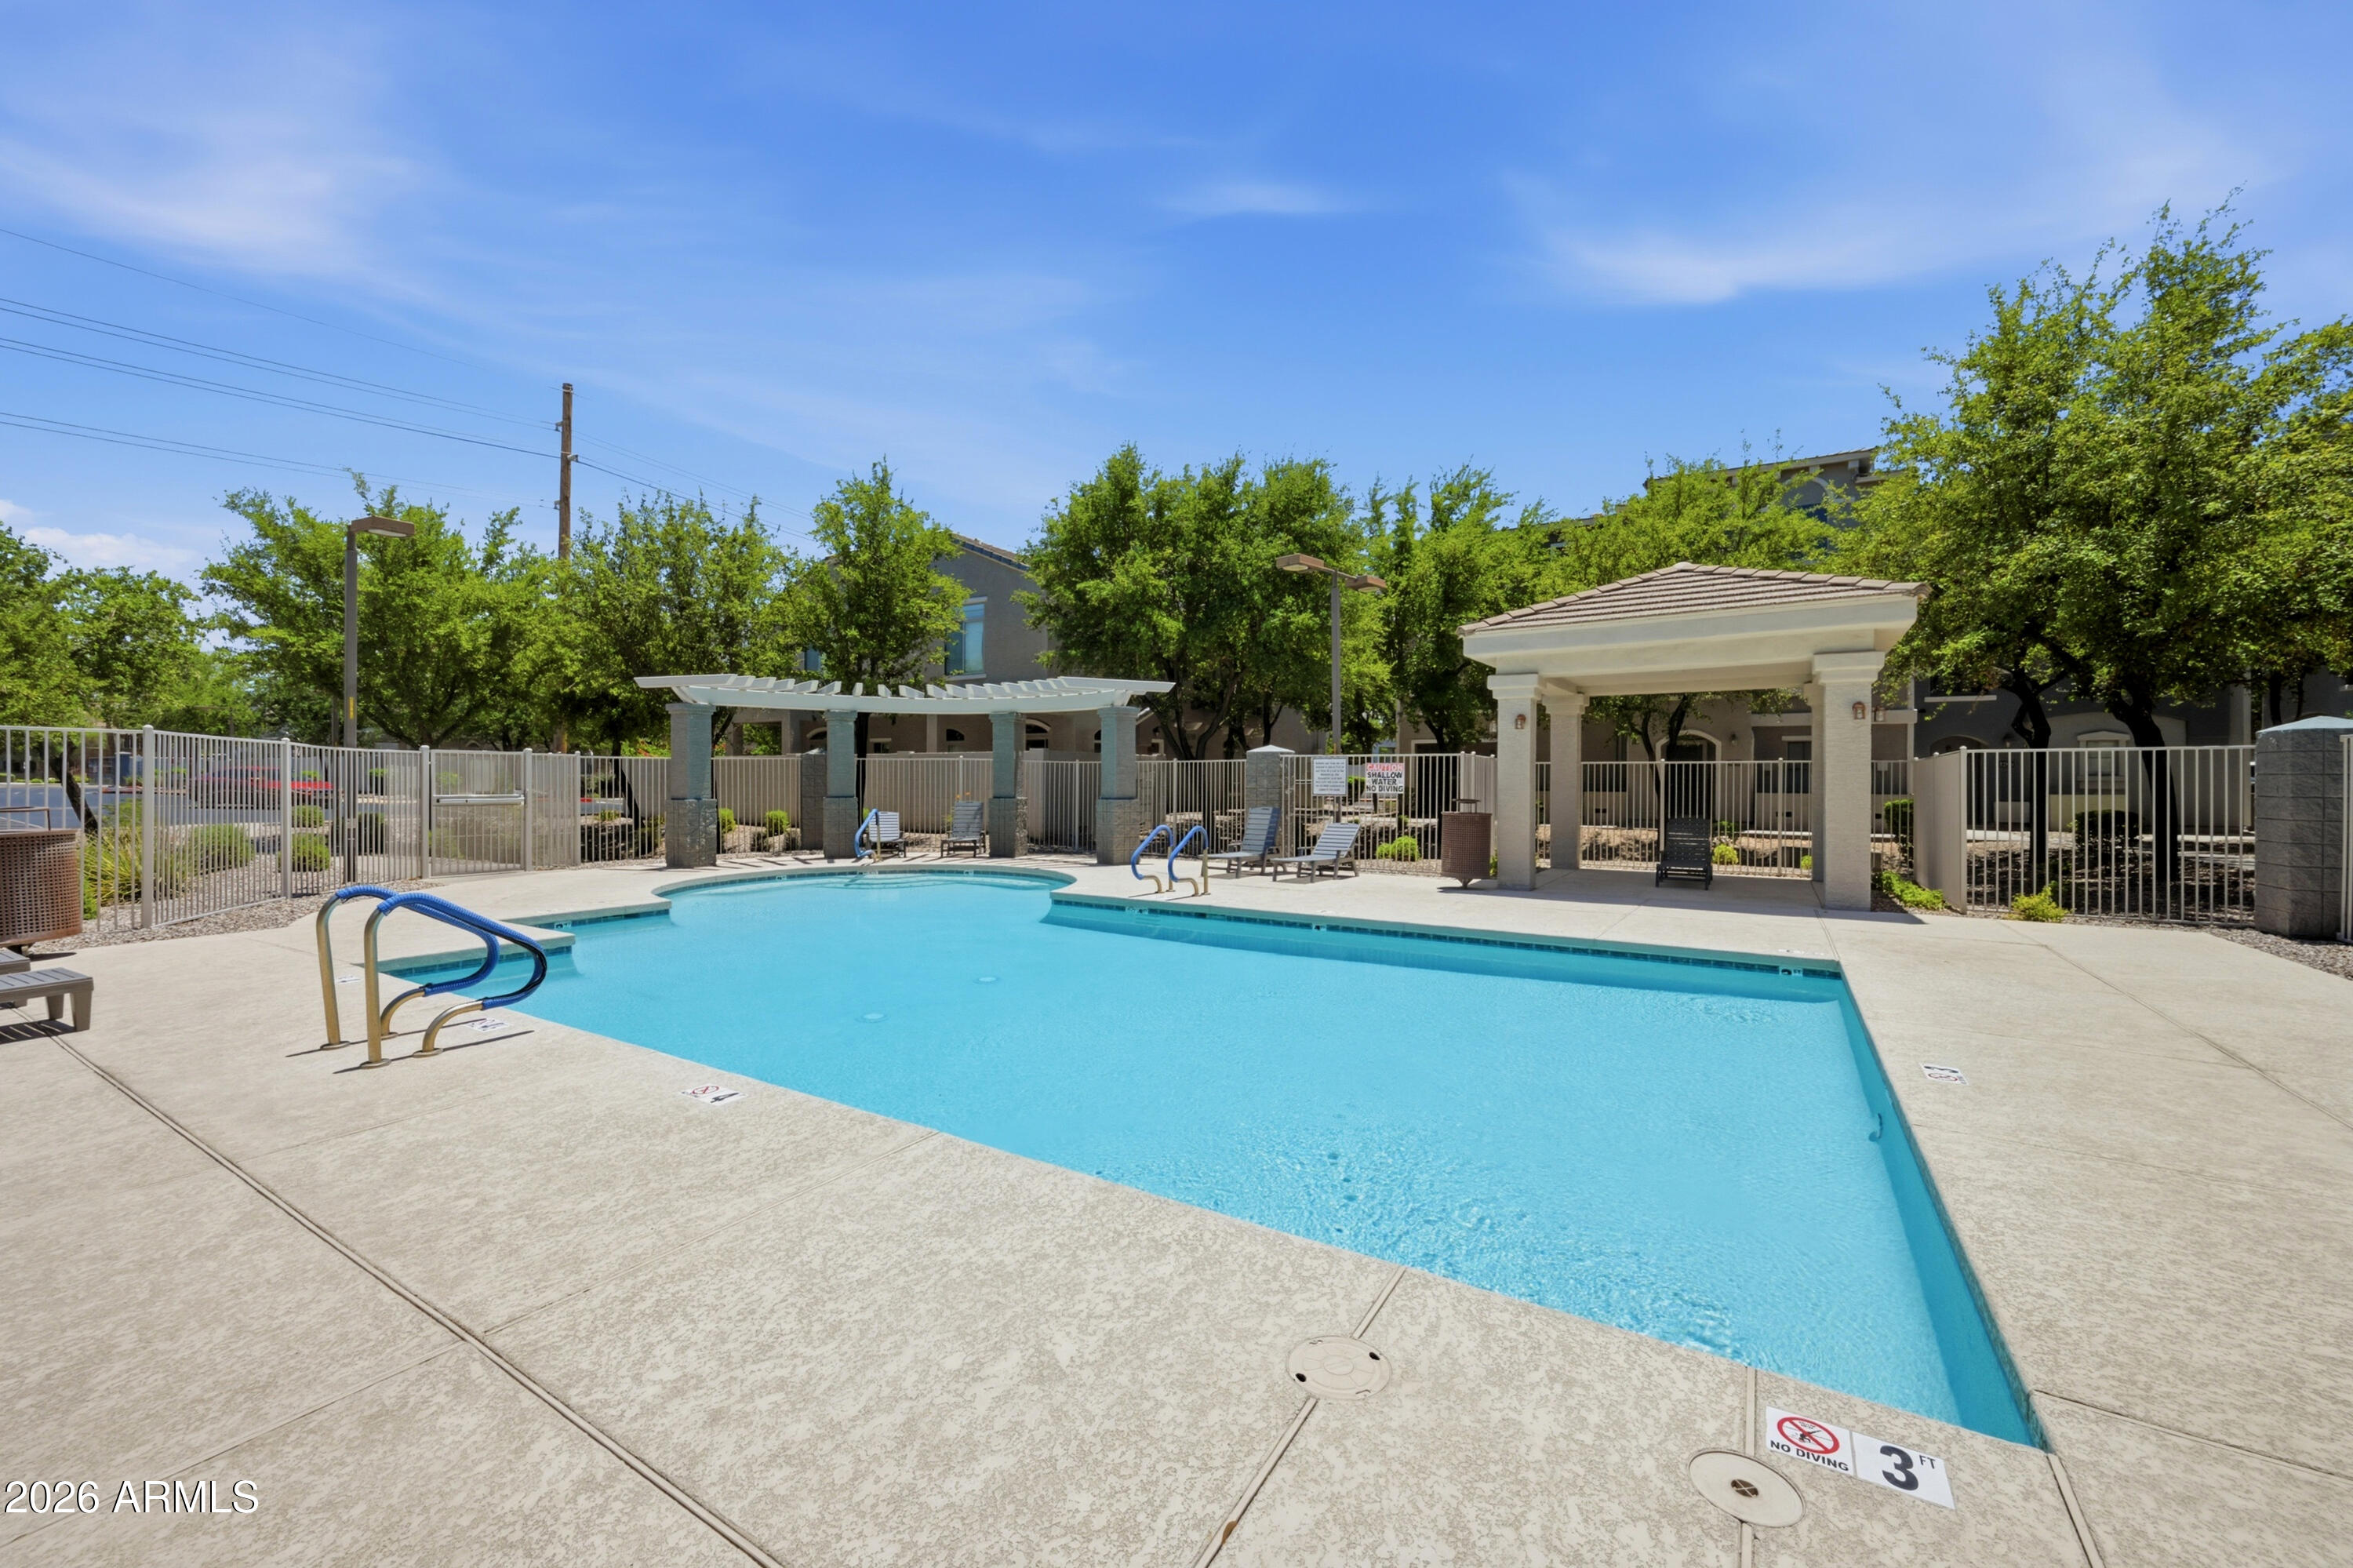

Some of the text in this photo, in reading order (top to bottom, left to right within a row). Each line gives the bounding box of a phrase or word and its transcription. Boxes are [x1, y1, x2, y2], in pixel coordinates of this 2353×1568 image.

[1770, 1440, 1849, 1472] NO DIVING
[1879, 1445, 1936, 1491] 3 FT
